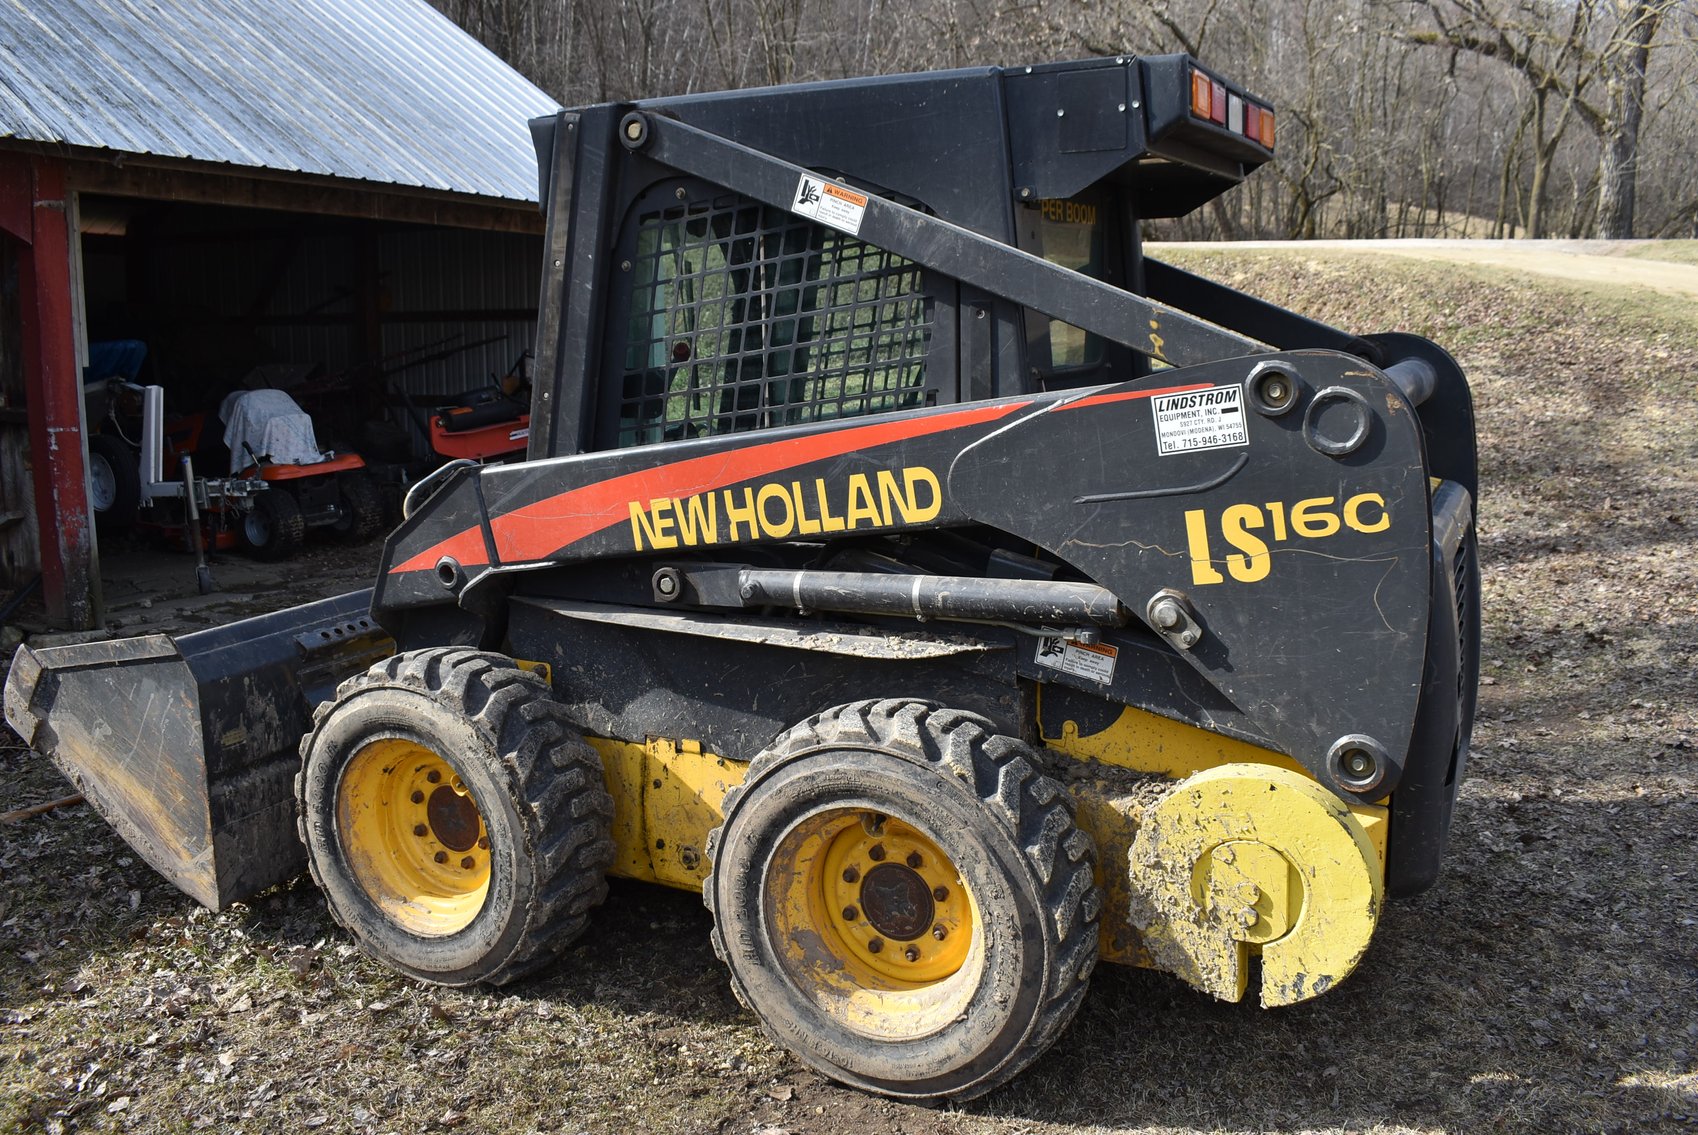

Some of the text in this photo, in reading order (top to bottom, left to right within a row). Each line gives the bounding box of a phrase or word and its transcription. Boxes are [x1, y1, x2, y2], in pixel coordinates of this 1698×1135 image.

[833, 189, 863, 204] WARNING
[1066, 202, 1096, 224] BOOM
[1158, 389, 1237, 412] LINDSTROM
[1159, 408, 1220, 422] EQUIPMENT, INC.
[1161, 429, 1187, 438] MONDOVI
[1163, 431, 1244, 450] Tel. 715-946-3168
[628, 466, 942, 552] NEW HOLLAND
